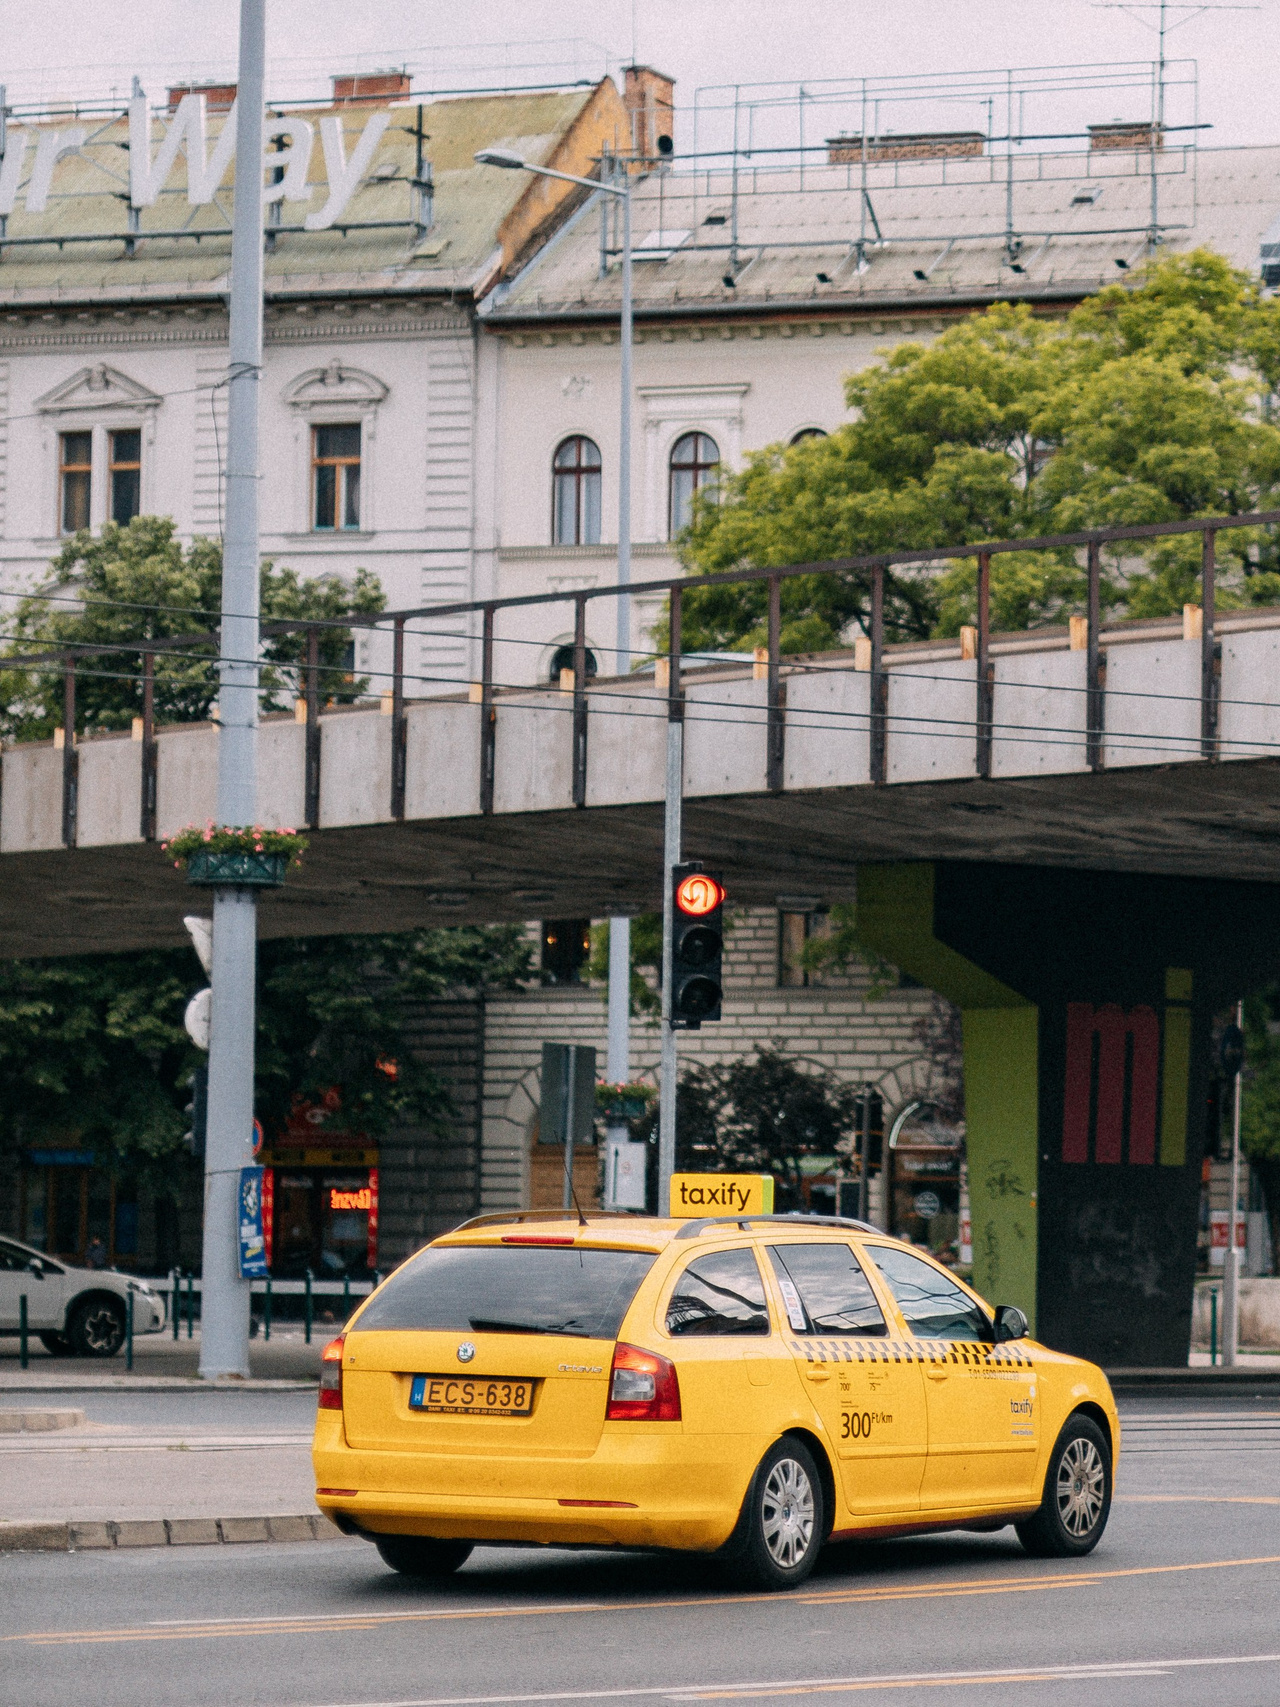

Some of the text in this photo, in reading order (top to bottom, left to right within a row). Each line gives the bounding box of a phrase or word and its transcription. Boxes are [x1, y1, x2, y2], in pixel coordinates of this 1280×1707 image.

[128, 93, 391, 231] Way
[680, 1182, 751, 1212] taxify
[558, 1363, 603, 1373] Octavia
[414, 1393, 421, 1401] H
[428, 1381, 526, 1407] ECS-638
[1010, 1398, 1033, 1417] taxify
[841, 1411, 893, 1439] 300 Ft/km
